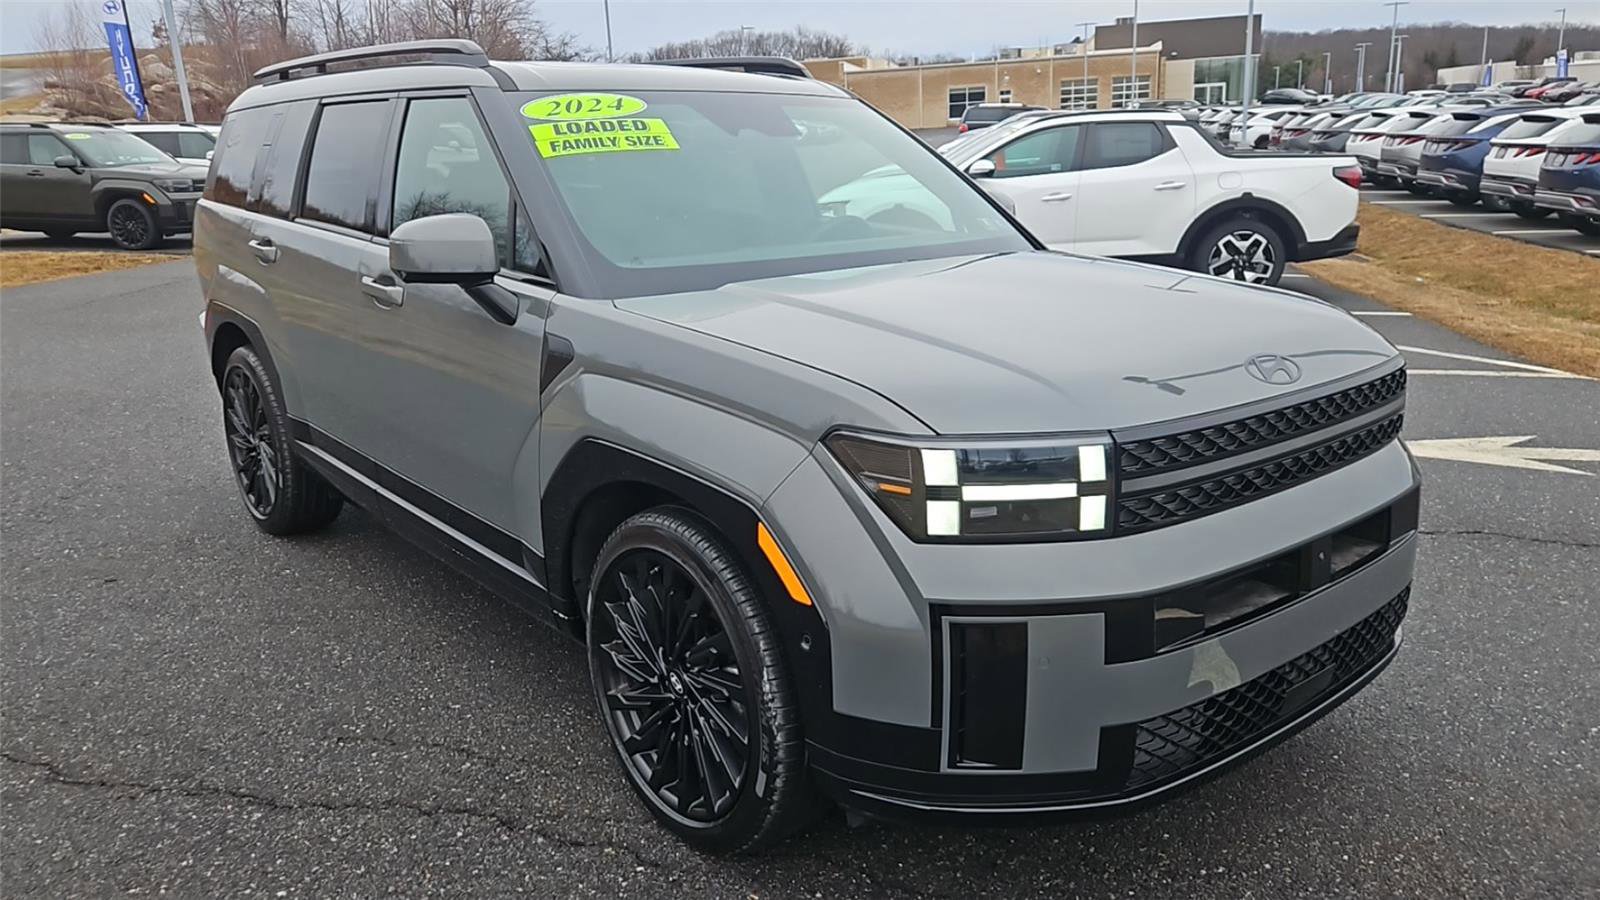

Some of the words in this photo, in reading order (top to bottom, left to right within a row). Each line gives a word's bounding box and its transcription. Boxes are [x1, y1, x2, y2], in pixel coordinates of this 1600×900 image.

[115, 29, 144, 112] HYUND
[546, 97, 624, 116] 2024
[553, 119, 648, 136] LOADED
[550, 136, 618, 153] FAMILY
[624, 135, 666, 147] SIZE
